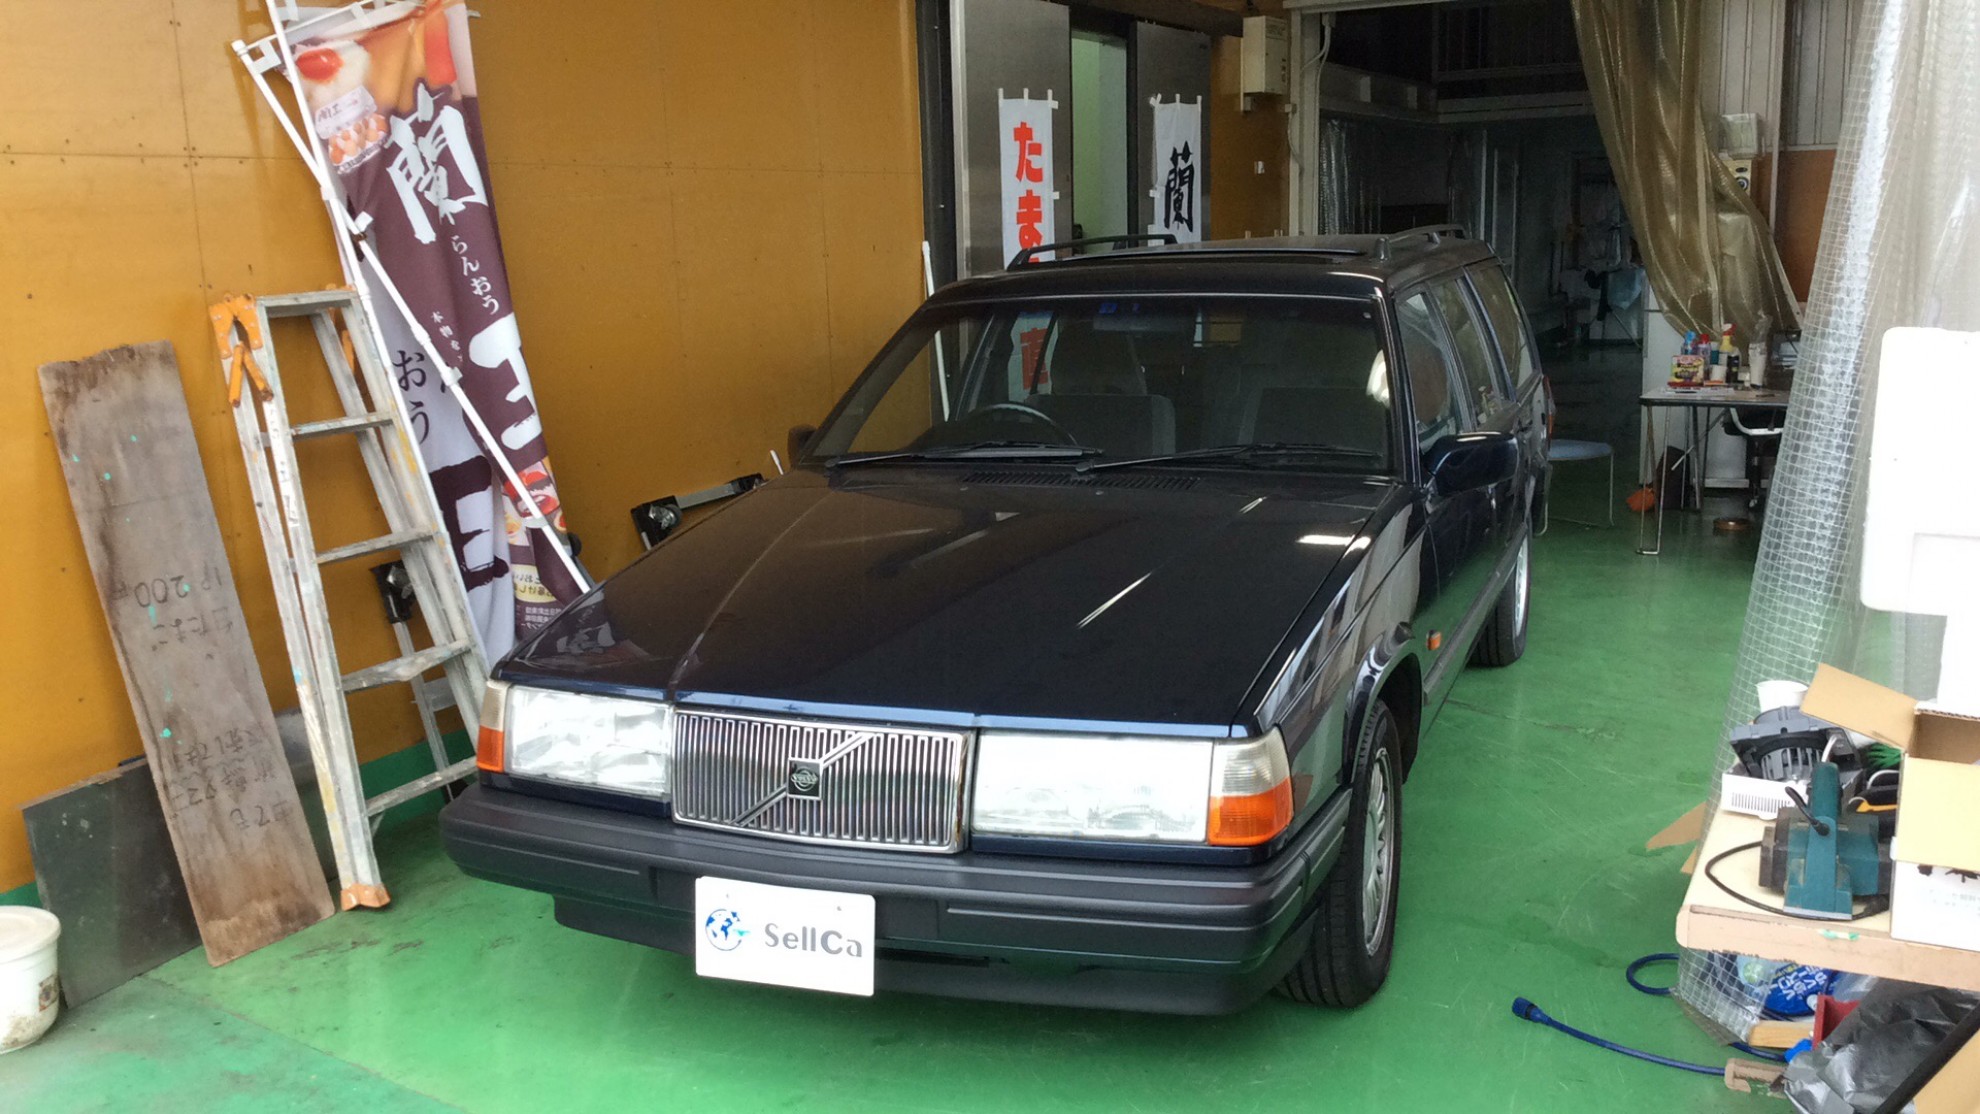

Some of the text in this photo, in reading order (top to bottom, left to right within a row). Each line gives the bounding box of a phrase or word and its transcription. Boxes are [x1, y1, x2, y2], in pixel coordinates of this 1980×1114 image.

[384, 82, 489, 245] 蘭
[1013, 121, 1044, 264] たま
[1164, 140, 1195, 233] 蘭
[450, 234, 501, 316] らんおう
[764, 922, 863, 959] SellCa
